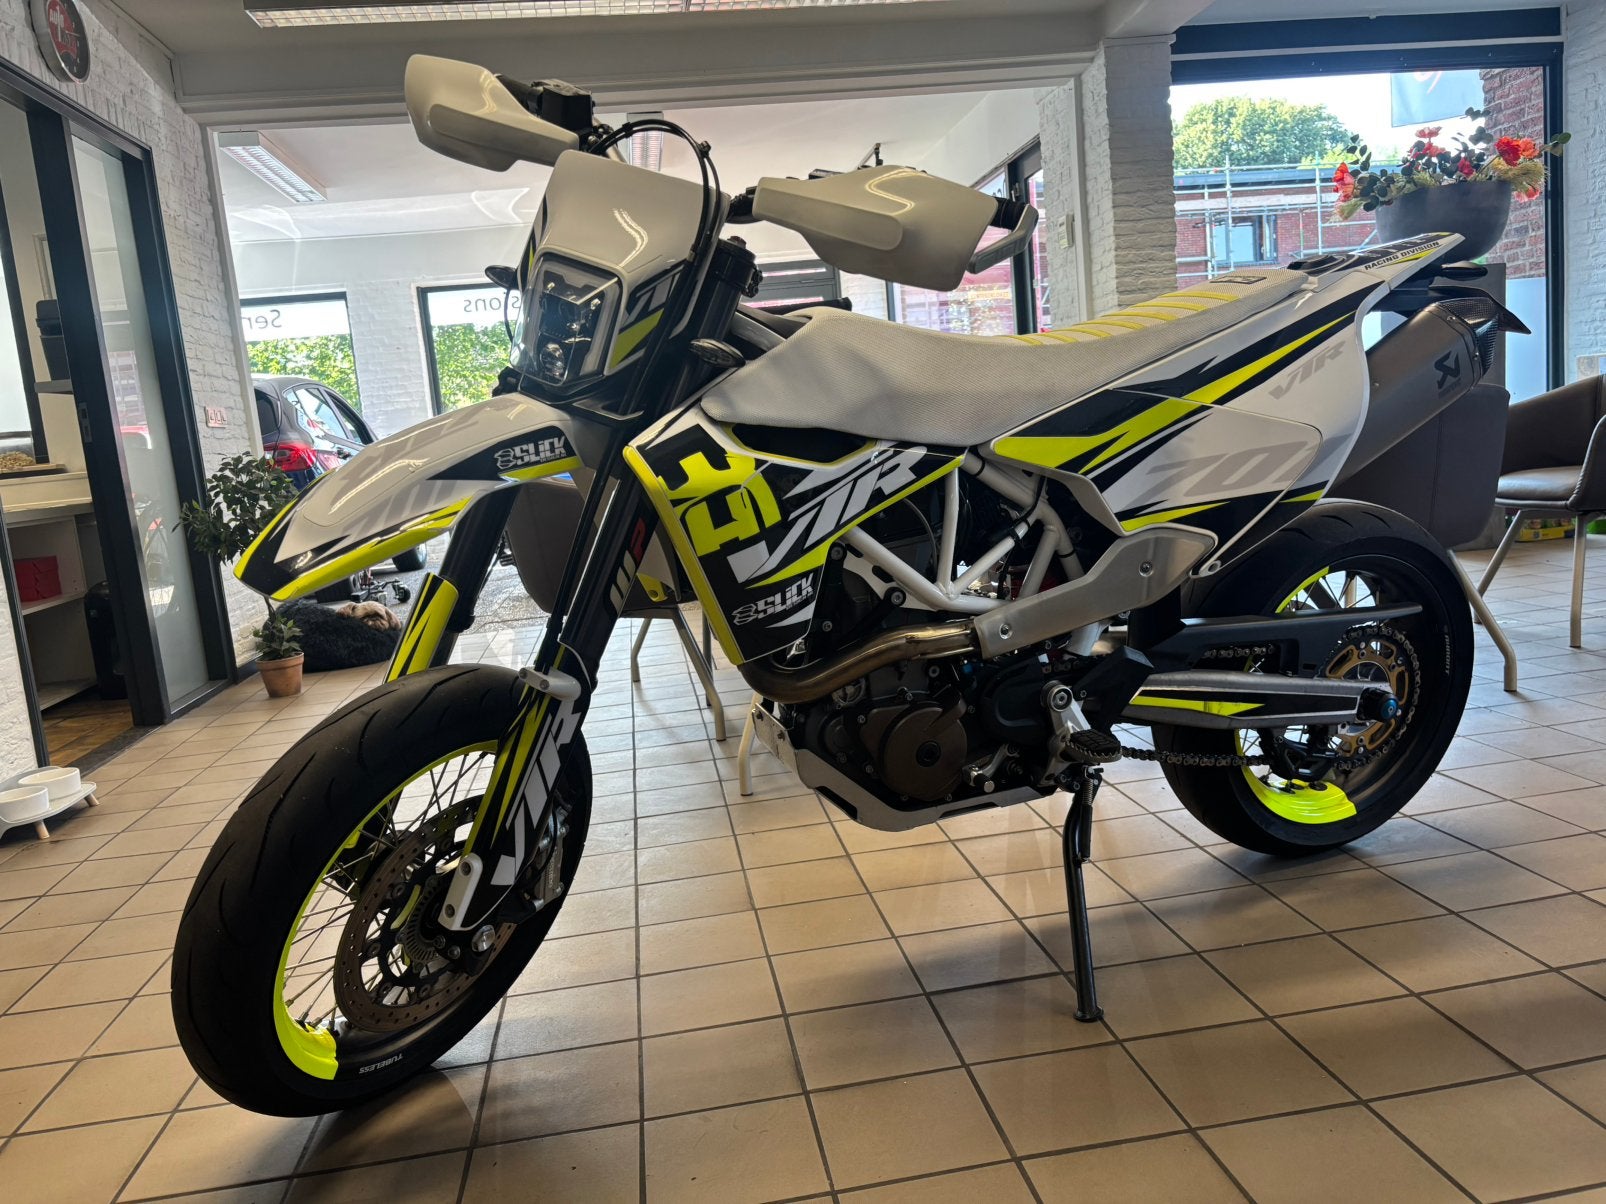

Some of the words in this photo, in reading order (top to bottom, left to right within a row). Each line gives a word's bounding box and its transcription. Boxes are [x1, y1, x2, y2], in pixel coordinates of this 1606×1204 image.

[1364, 252, 1400, 271] RACING
[1400, 241, 1440, 258] DIVISION
[358, 1052, 404, 1075] TUBELESS
